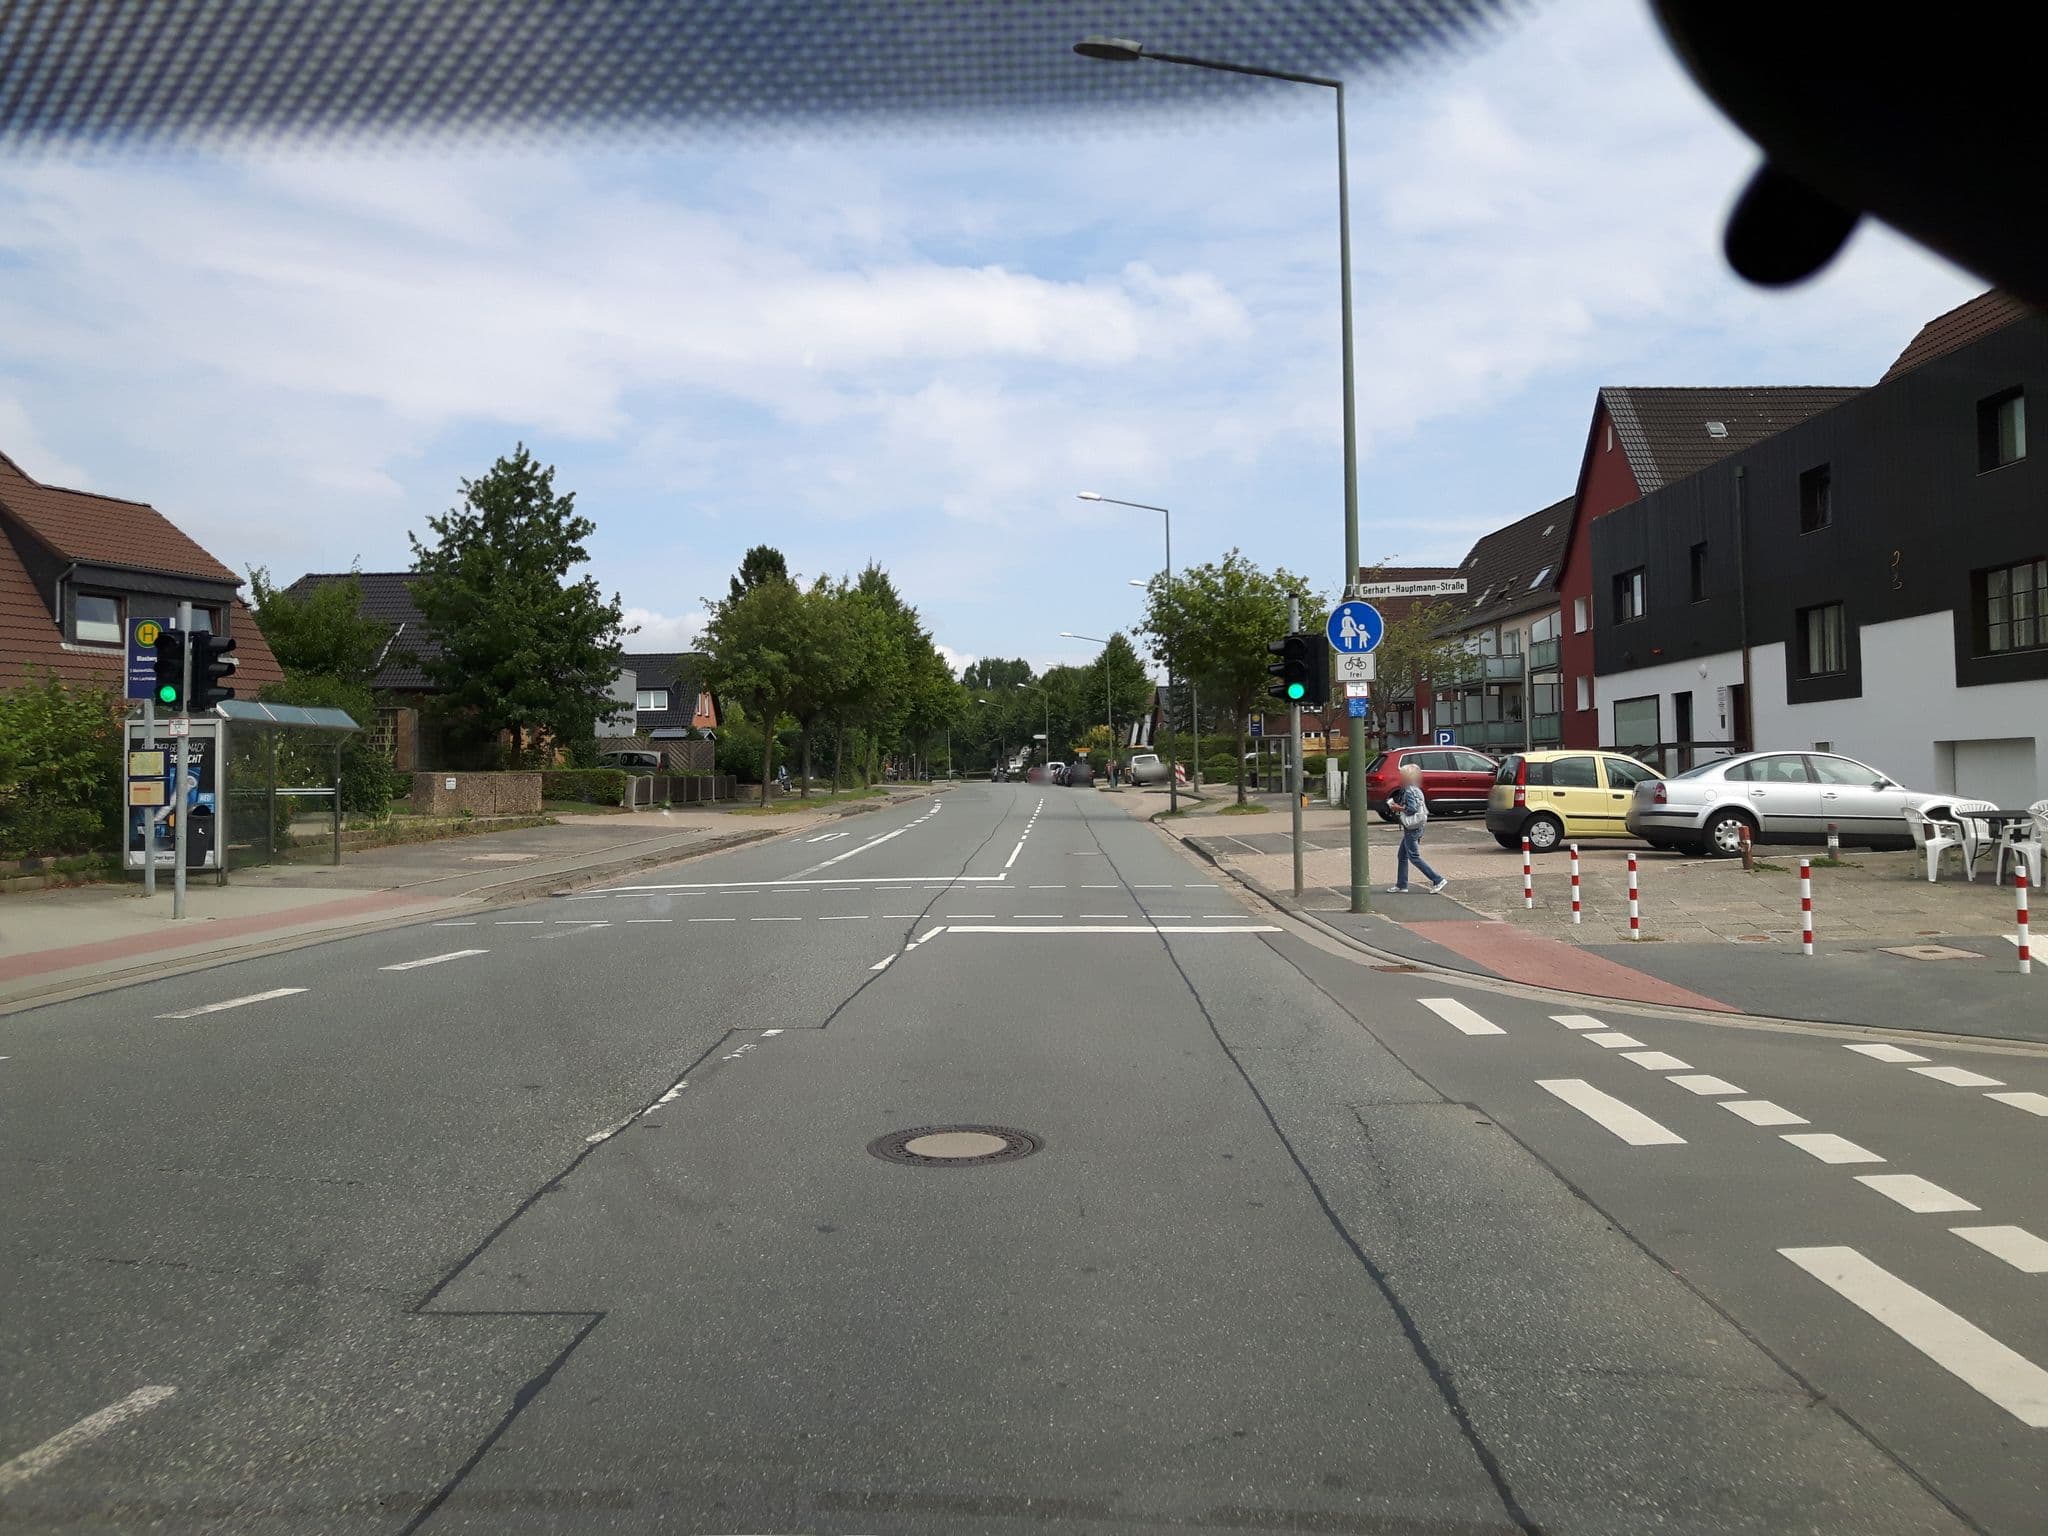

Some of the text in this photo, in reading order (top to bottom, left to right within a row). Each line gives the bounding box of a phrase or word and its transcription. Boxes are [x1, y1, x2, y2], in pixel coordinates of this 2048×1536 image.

[1362, 582, 1465, 595] Gerhart-Hauptmann-Straße
[143, 626, 154, 641] H
[1440, 733, 1450, 747] P
